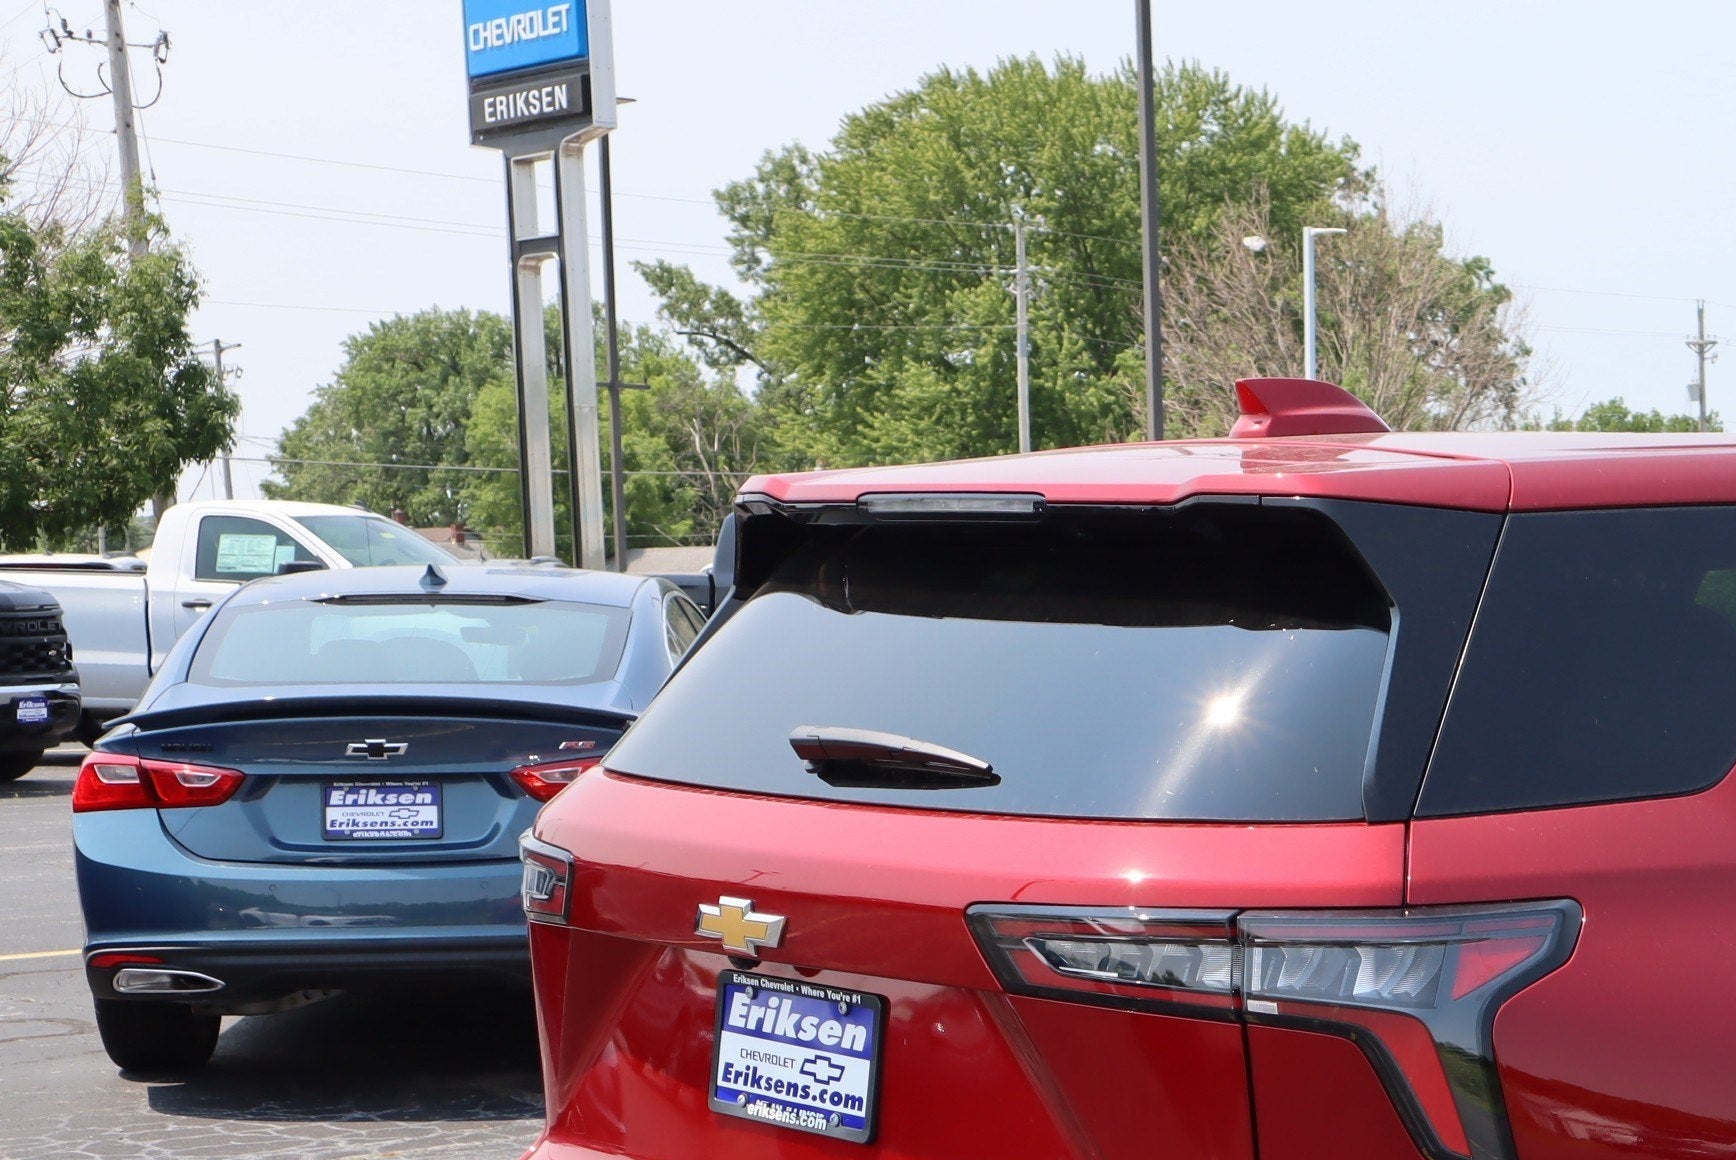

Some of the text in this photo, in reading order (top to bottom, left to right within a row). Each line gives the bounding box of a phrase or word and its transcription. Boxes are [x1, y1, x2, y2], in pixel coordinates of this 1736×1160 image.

[469, 4, 571, 51] CHEVROLET
[484, 84, 568, 123] ERIKSEN
[329, 789, 433, 805] Eriksen
[329, 819, 434, 828] Eriksens.com
[733, 974, 862, 1004] Eriksen Chevrolet Where You're #1
[728, 991, 867, 1052] Eriksen
[740, 1048, 796, 1069] CHEVROLET
[722, 1061, 864, 1112] Eriksens.com
[747, 1103, 827, 1131] eriksens.com
